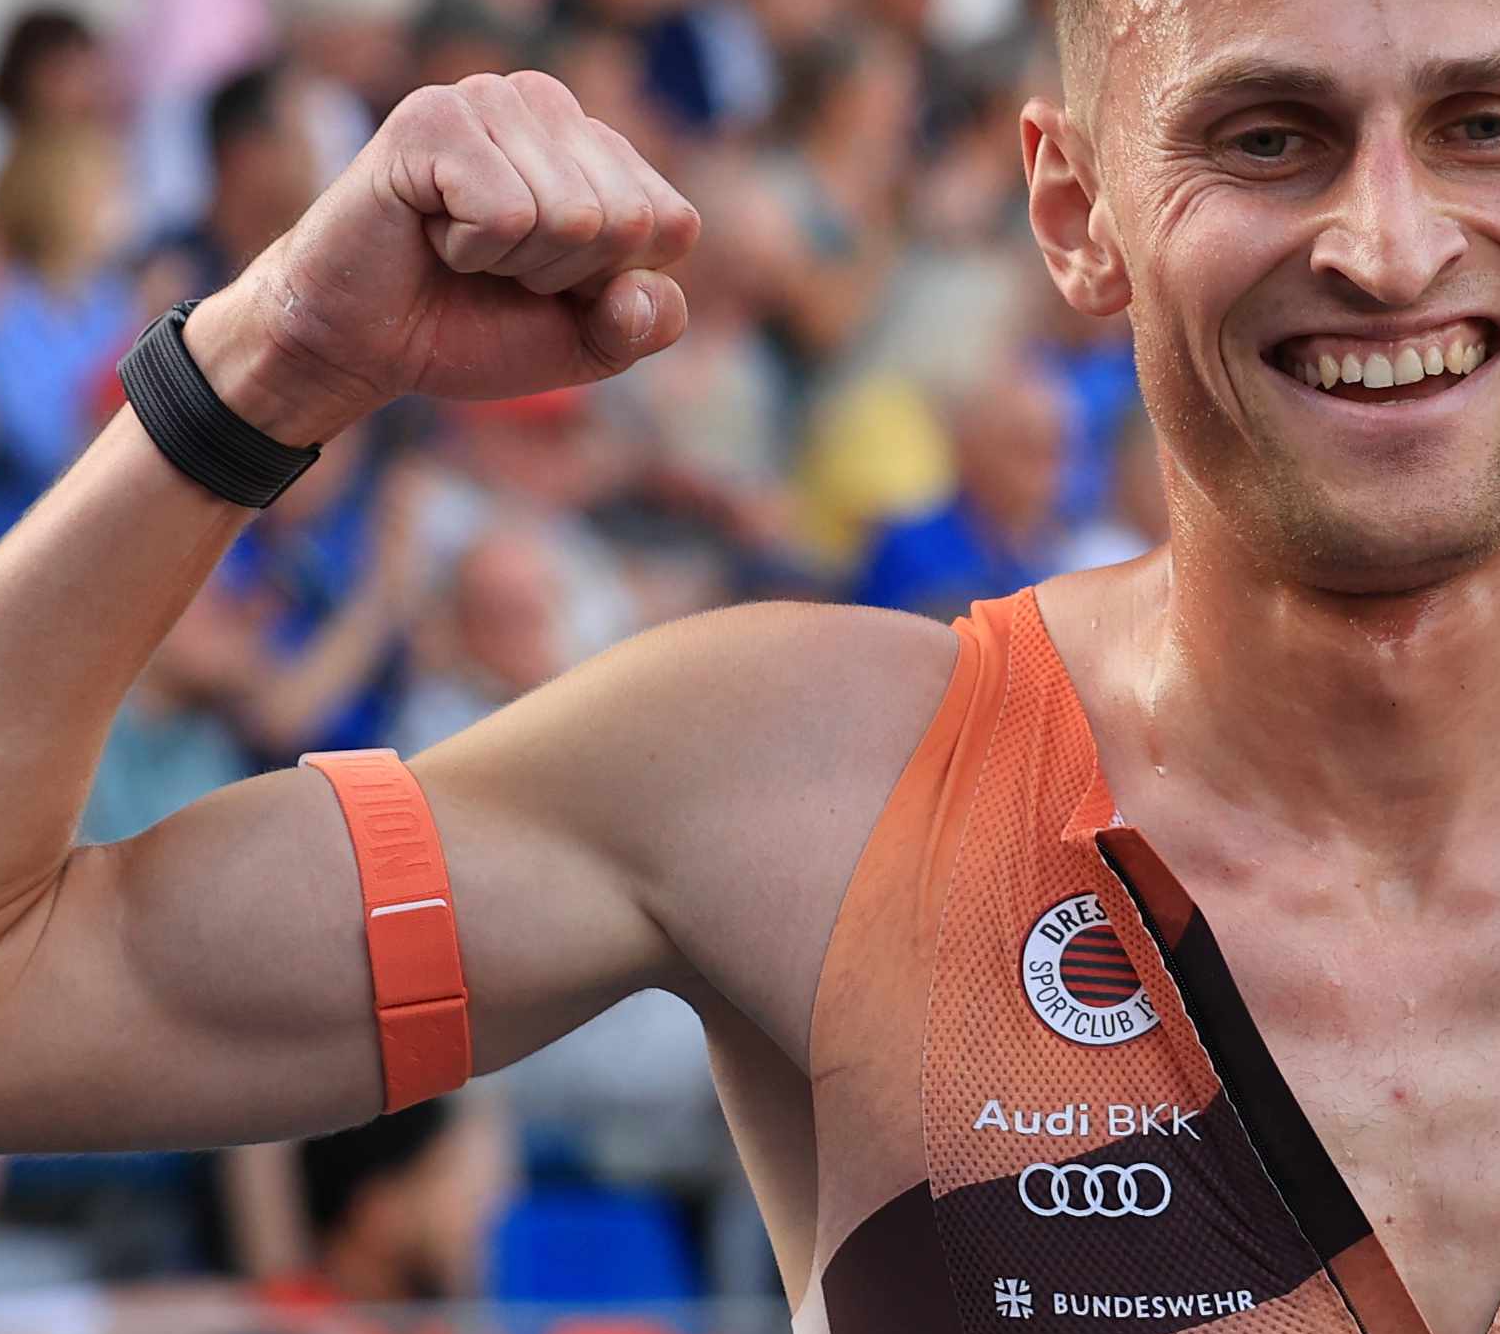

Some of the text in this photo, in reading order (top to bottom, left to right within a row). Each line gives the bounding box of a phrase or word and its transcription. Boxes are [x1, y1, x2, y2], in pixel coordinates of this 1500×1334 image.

[1028, 960, 1135, 1038] SPORTCLUB
[972, 1098, 1202, 1141] Audi BKK
[1052, 1289, 1257, 1318] BUNDESWEHR
